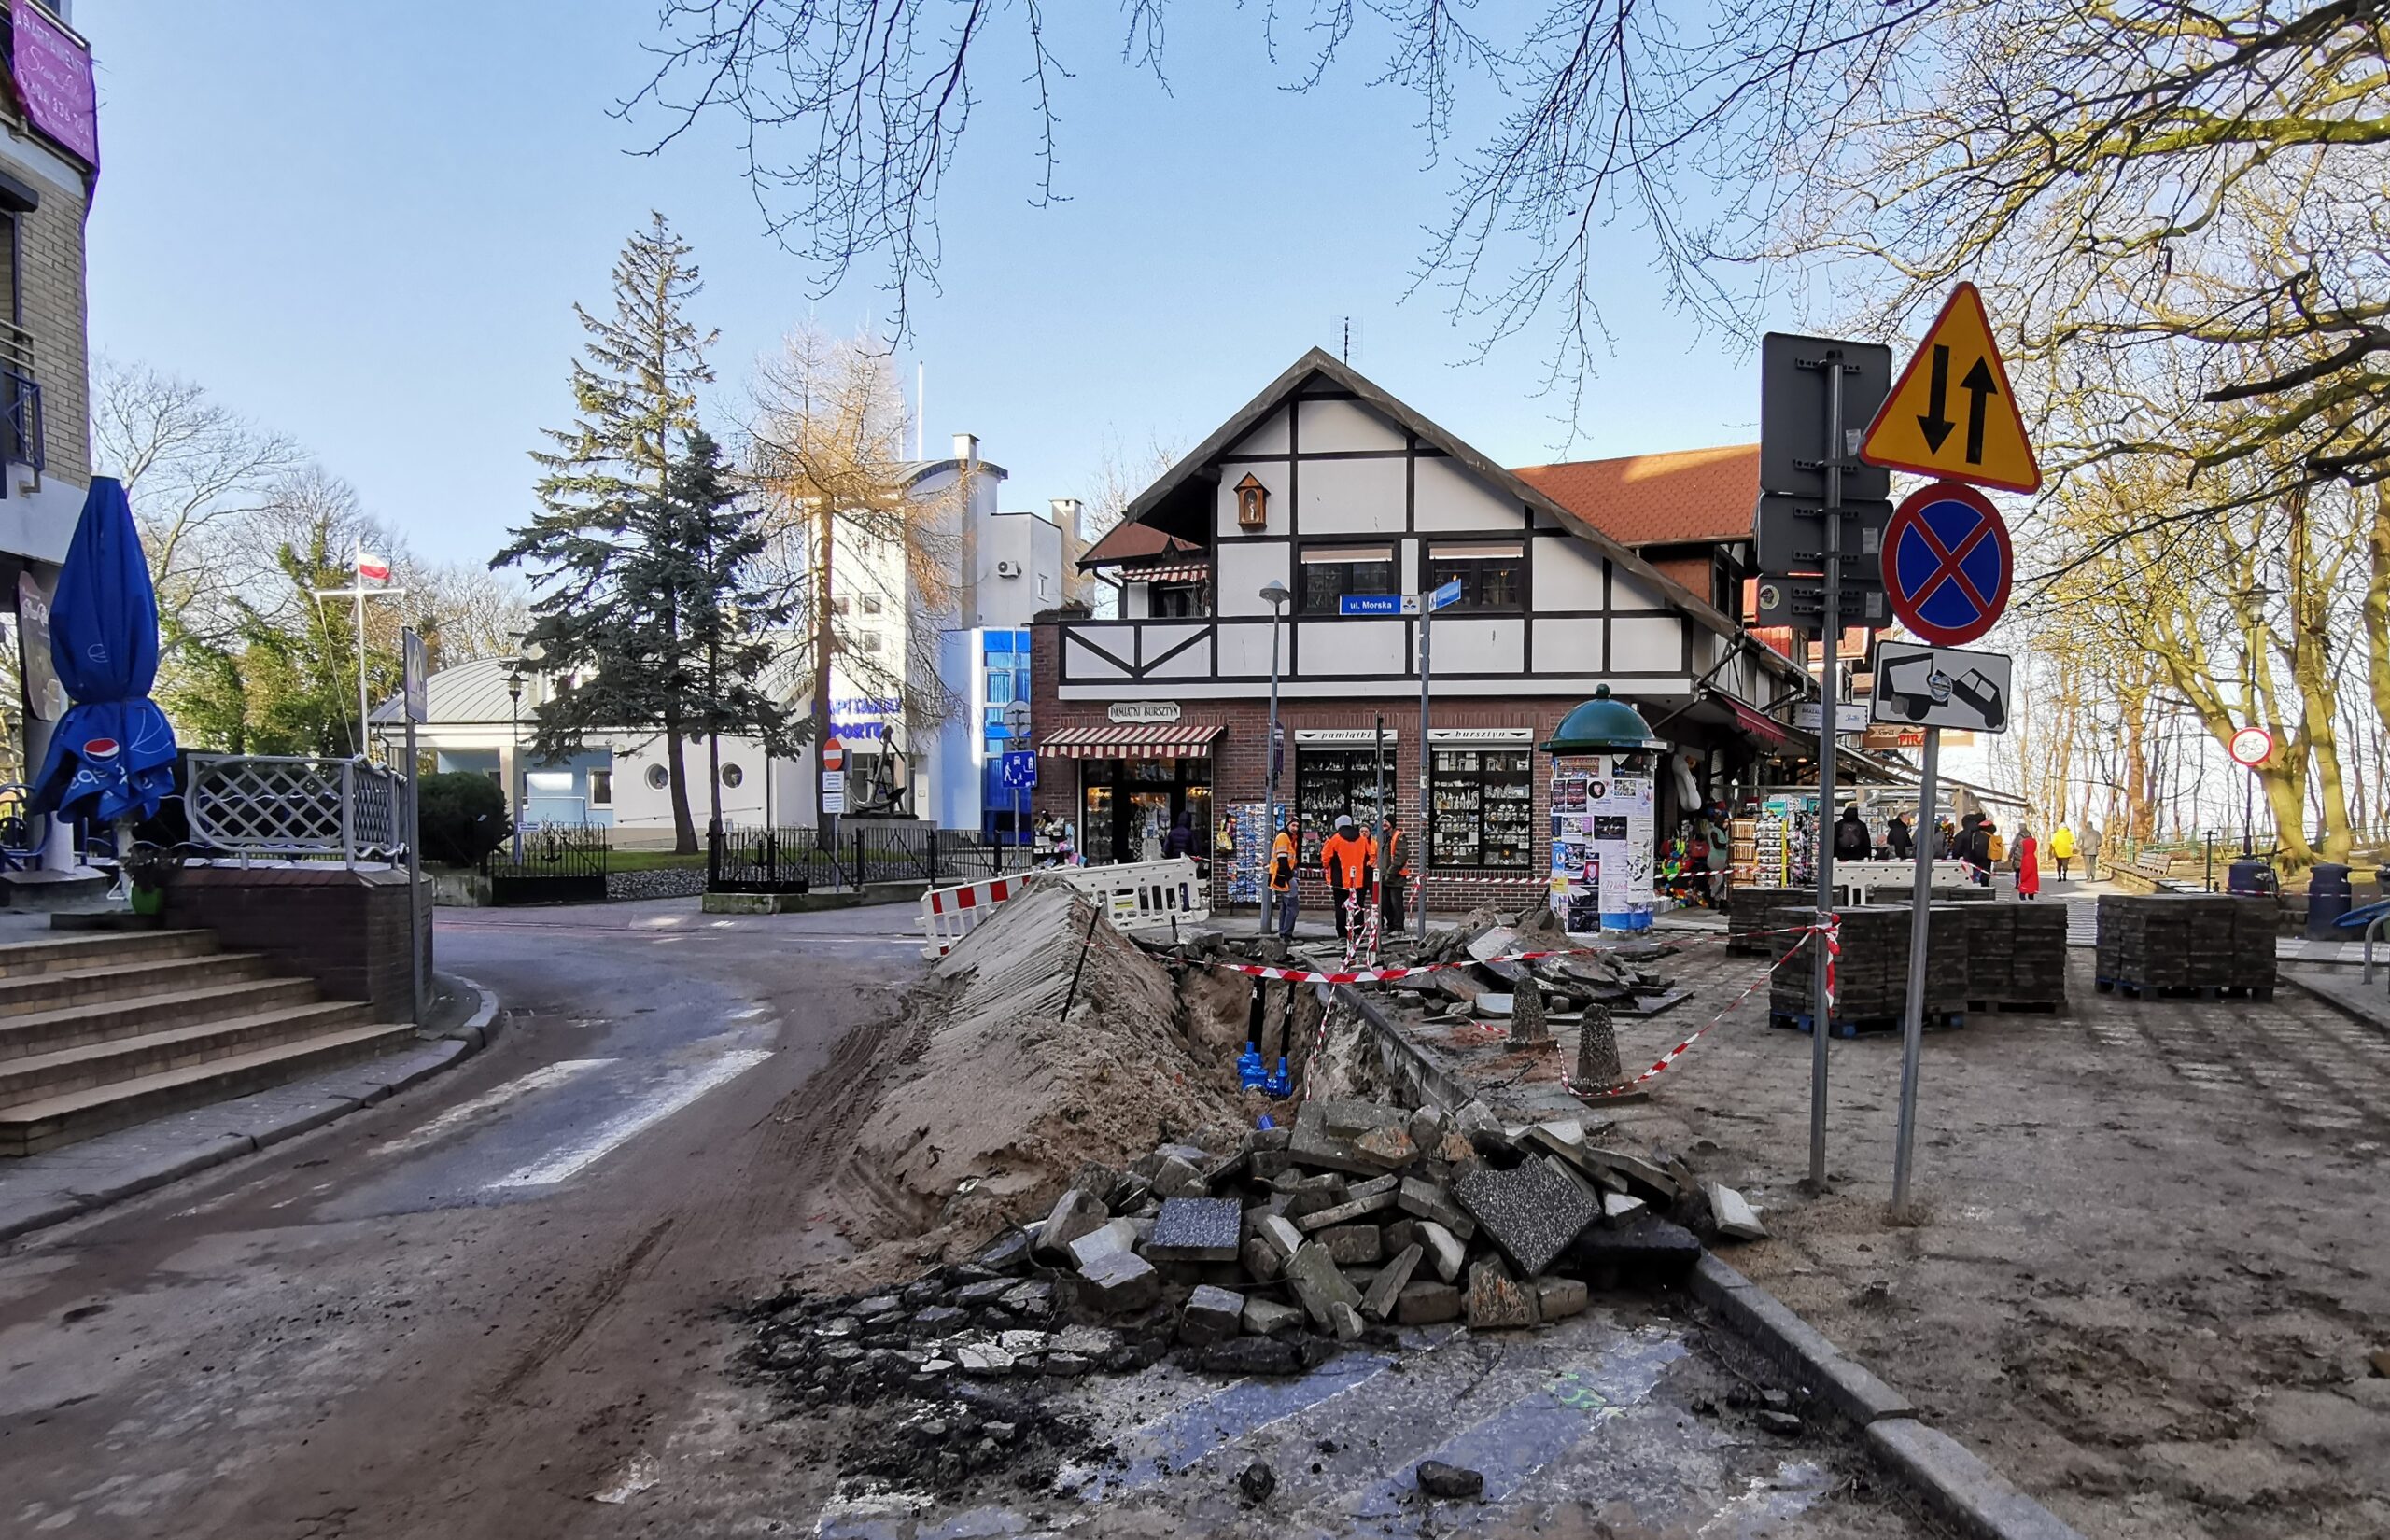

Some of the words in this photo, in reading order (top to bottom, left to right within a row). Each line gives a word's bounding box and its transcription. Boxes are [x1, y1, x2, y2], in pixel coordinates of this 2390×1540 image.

[1363, 601, 1392, 609] Morska
[1144, 706, 1178, 717] BURSZTYN
[1455, 731, 1505, 739] bursztyn
